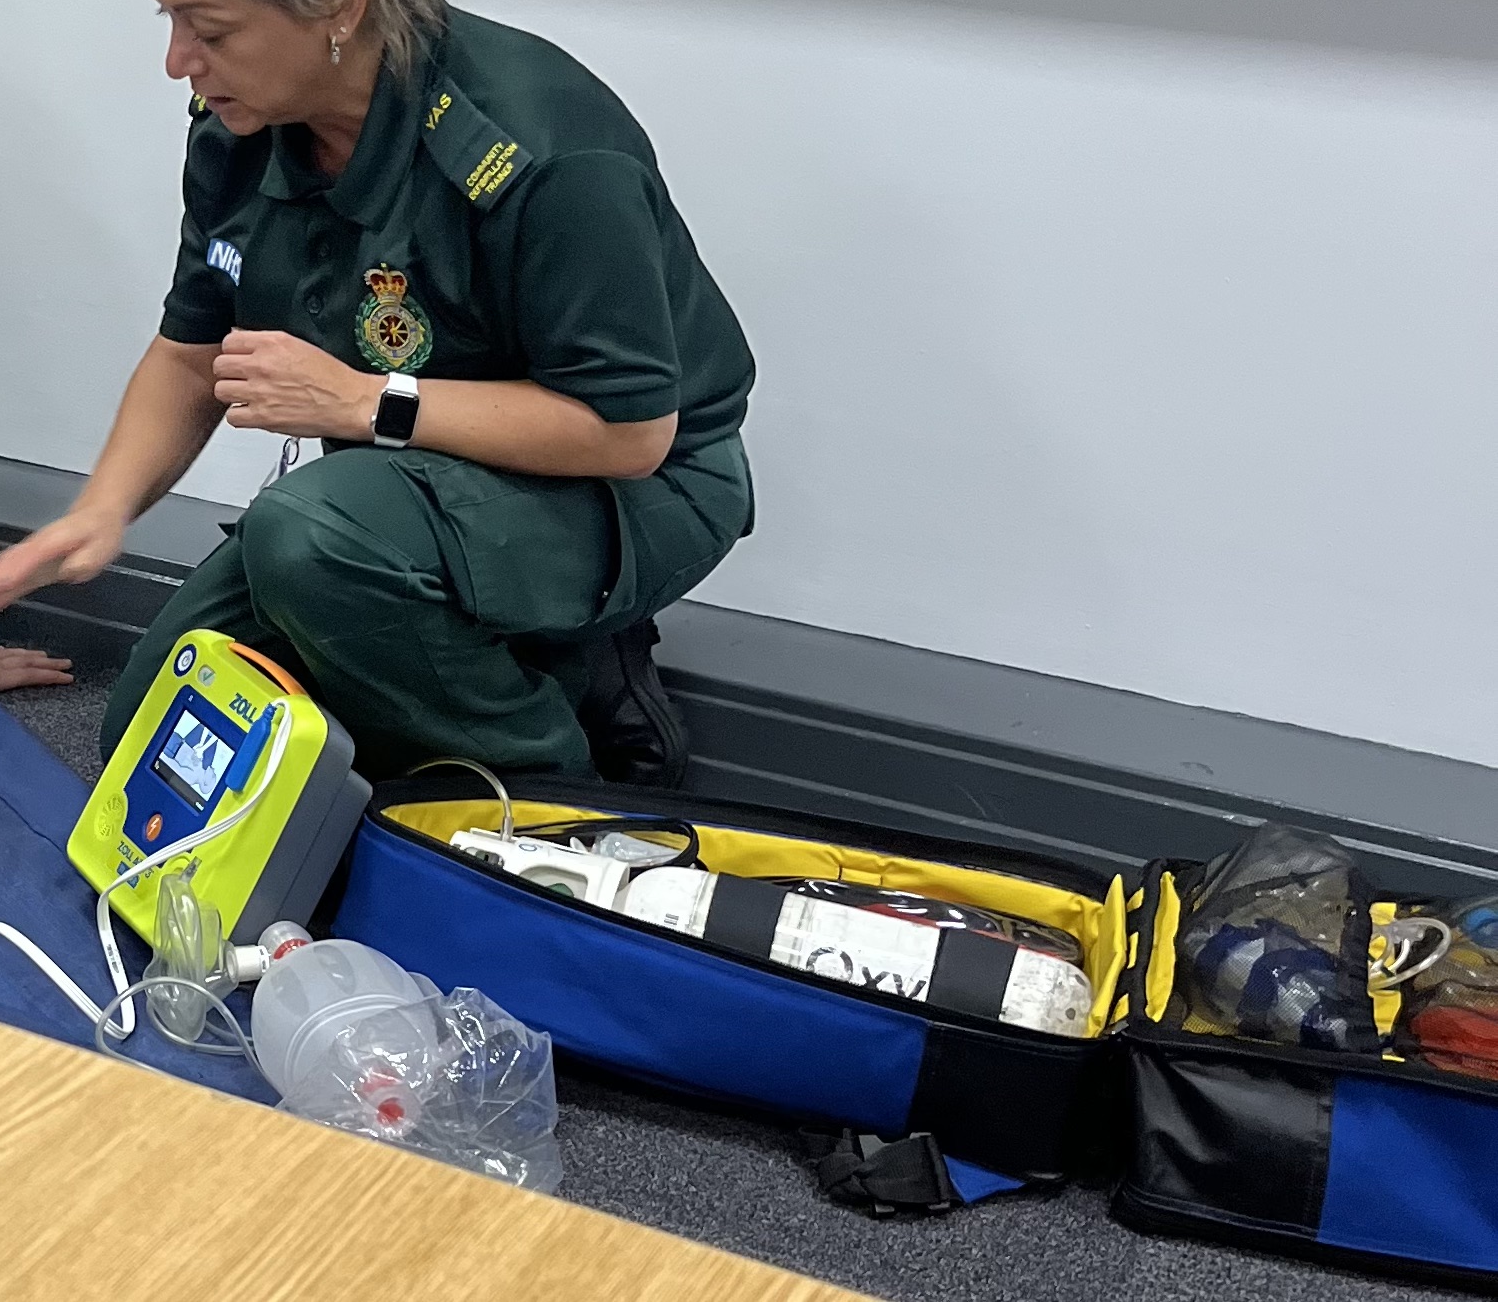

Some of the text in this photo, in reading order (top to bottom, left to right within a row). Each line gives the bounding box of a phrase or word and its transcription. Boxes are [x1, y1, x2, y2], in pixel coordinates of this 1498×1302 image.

[425, 93, 452, 130] YAS
[467, 142, 504, 187] COMMUNITY
[228, 692, 258, 723] ZOLL
